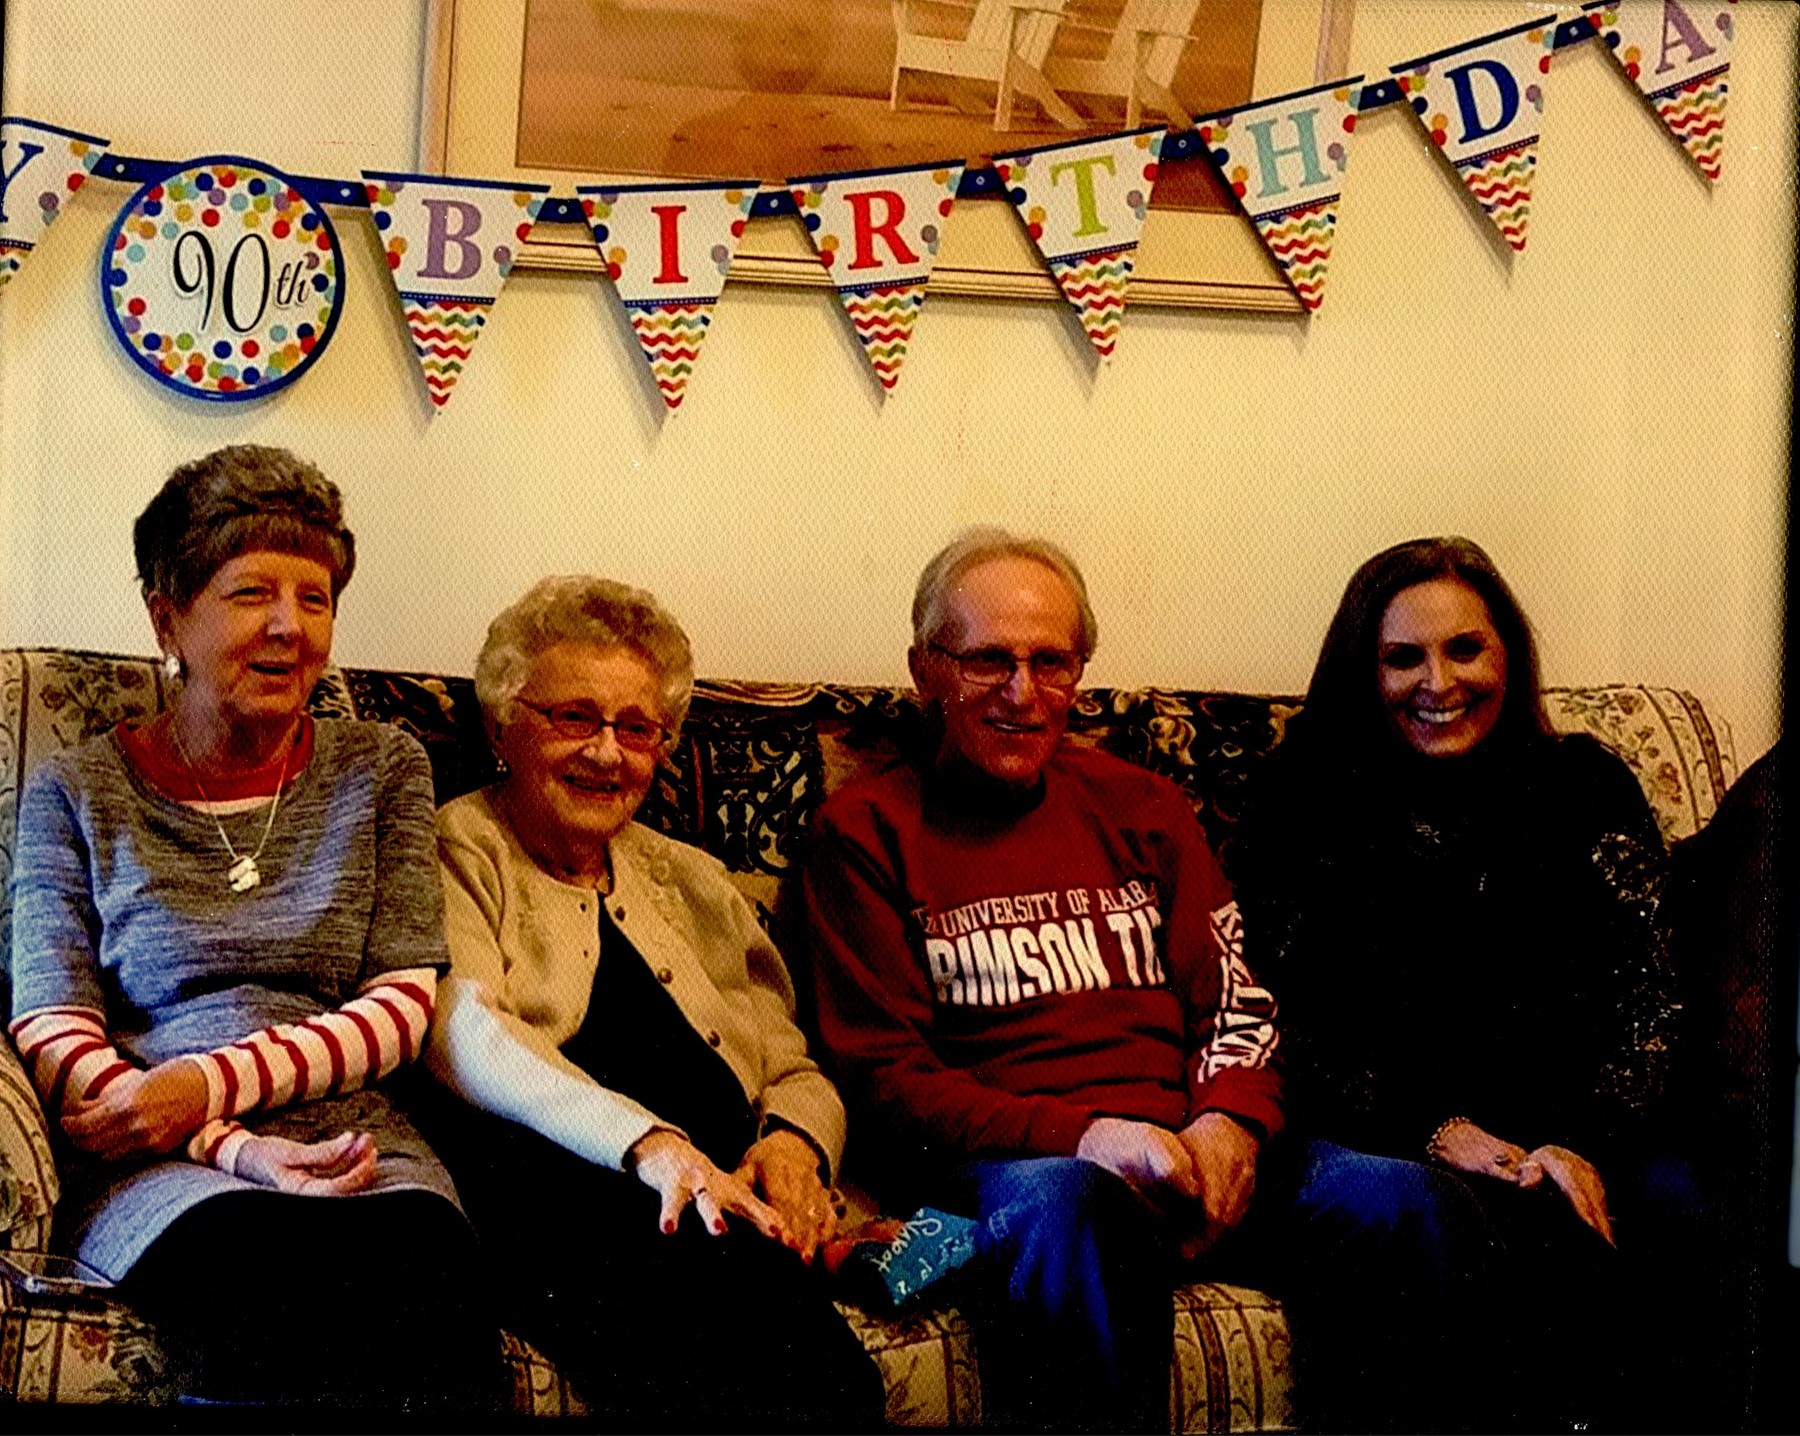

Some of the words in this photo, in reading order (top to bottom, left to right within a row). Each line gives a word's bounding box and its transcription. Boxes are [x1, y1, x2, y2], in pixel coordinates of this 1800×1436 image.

[173, 231, 310, 333] 90th
[938, 891, 1059, 938] UNIVERSITY
[1066, 888, 1091, 914] OF
